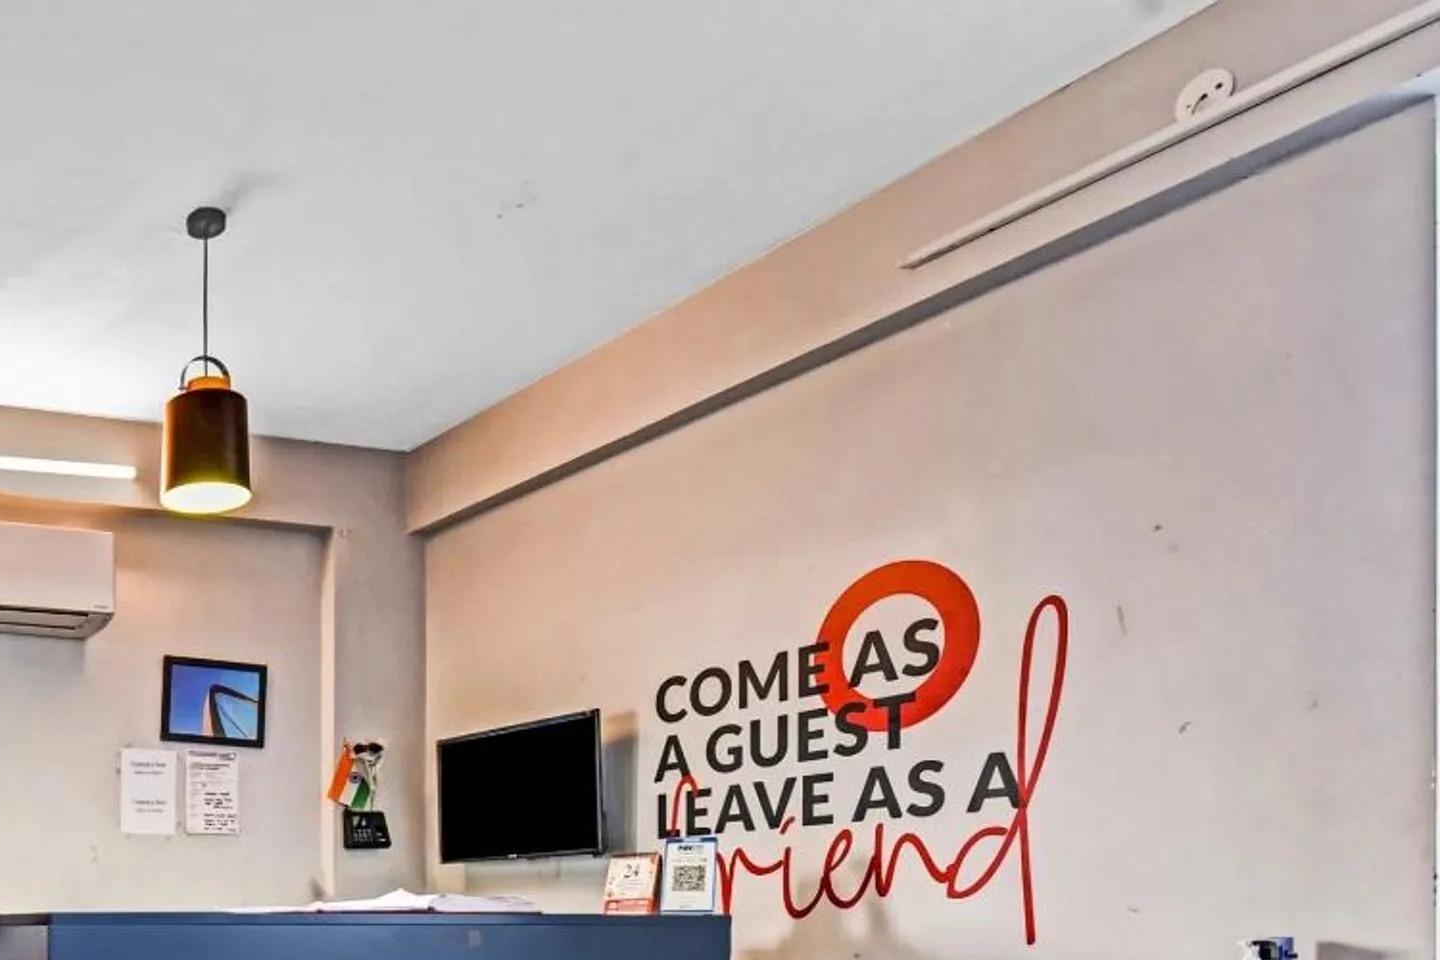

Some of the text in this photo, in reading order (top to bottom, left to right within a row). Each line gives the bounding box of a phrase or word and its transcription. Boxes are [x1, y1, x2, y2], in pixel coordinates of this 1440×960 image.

[655, 618, 940, 723] COME AS
[654, 692, 916, 783] A GUEST
[657, 751, 1022, 839] LEAVE AS A
